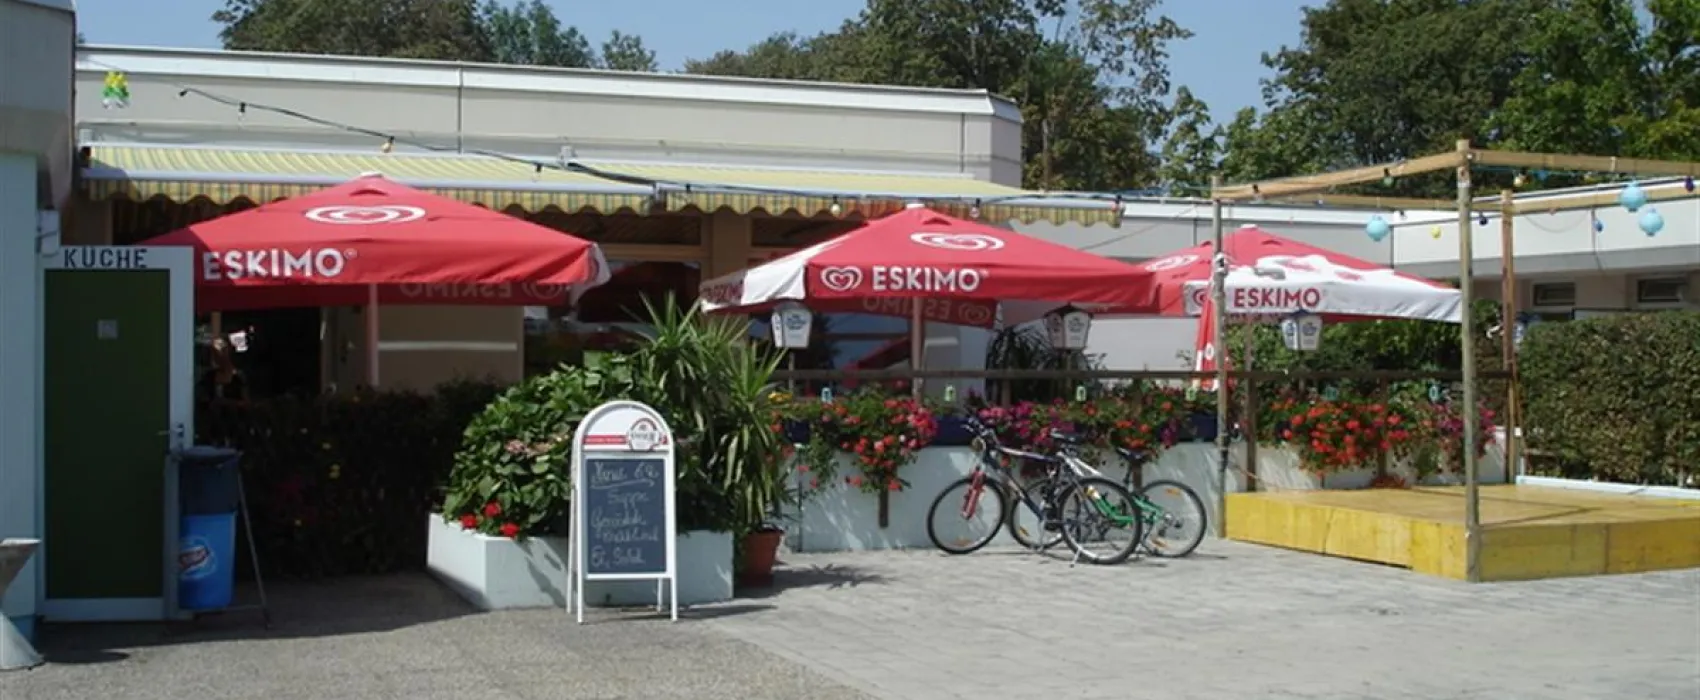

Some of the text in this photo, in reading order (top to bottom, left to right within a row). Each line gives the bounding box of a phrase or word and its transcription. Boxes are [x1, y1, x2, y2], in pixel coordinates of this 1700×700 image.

[203, 248, 343, 280] ESKIMO
[873, 265, 979, 292] ESKIMO
[1233, 287, 1320, 308] ESKIMO
